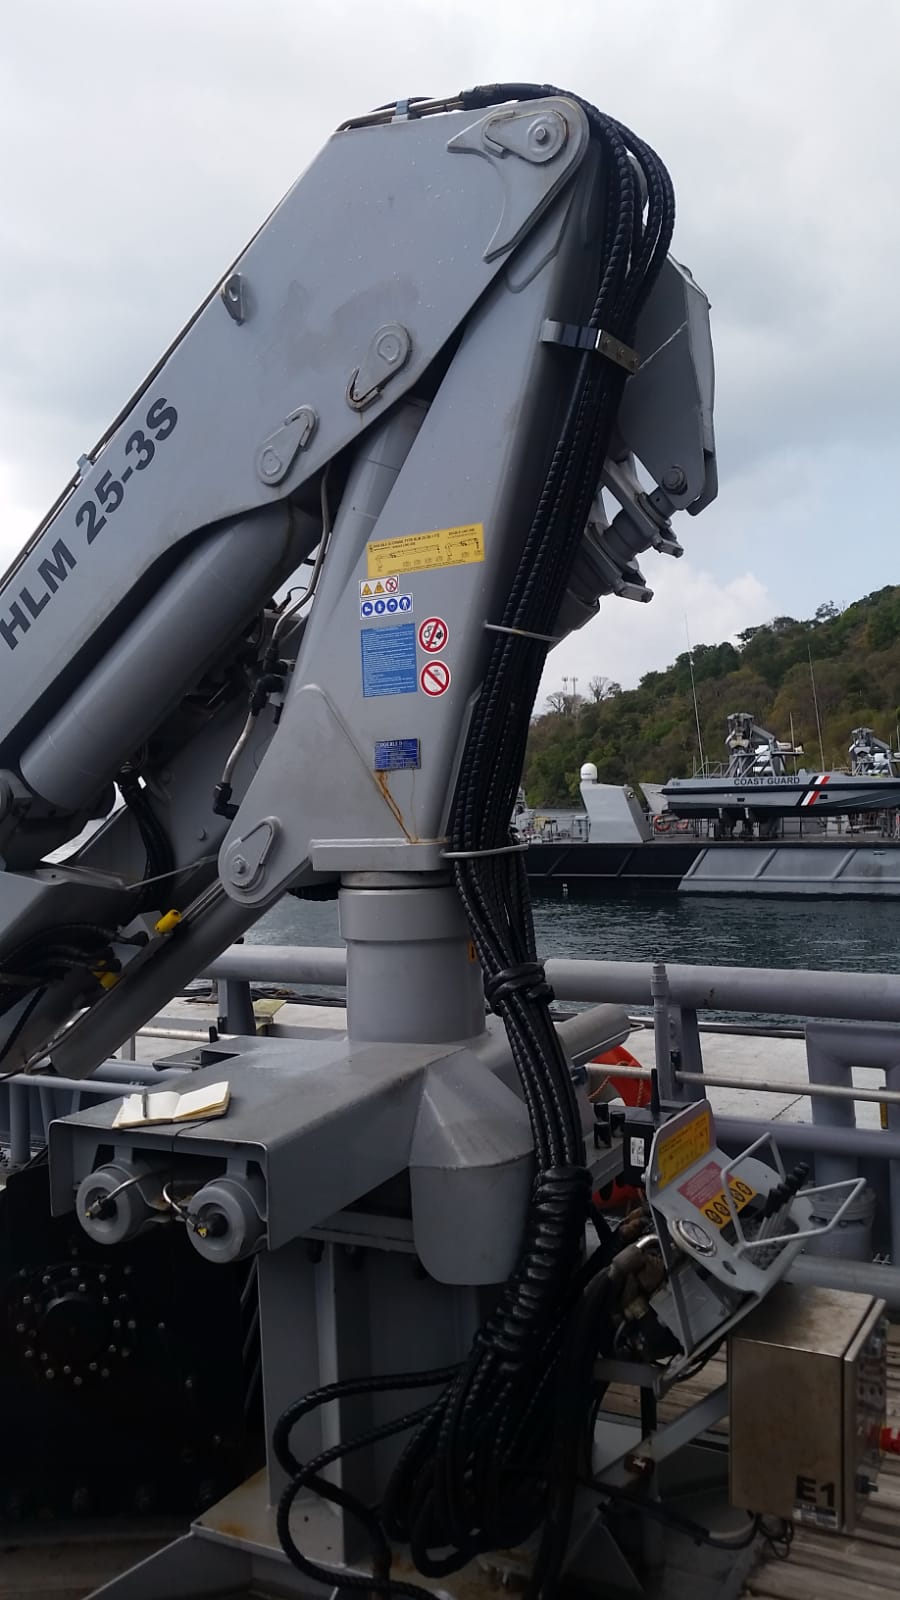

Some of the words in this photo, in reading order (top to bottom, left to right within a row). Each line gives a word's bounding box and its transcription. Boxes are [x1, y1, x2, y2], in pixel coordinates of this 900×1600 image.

[0, 538, 77, 650] HLM
[75, 397, 178, 545] 25-3S
[733, 778, 764, 786] COAST
[767, 776, 800, 785] GUARD
[796, 1474, 835, 1507] E1
